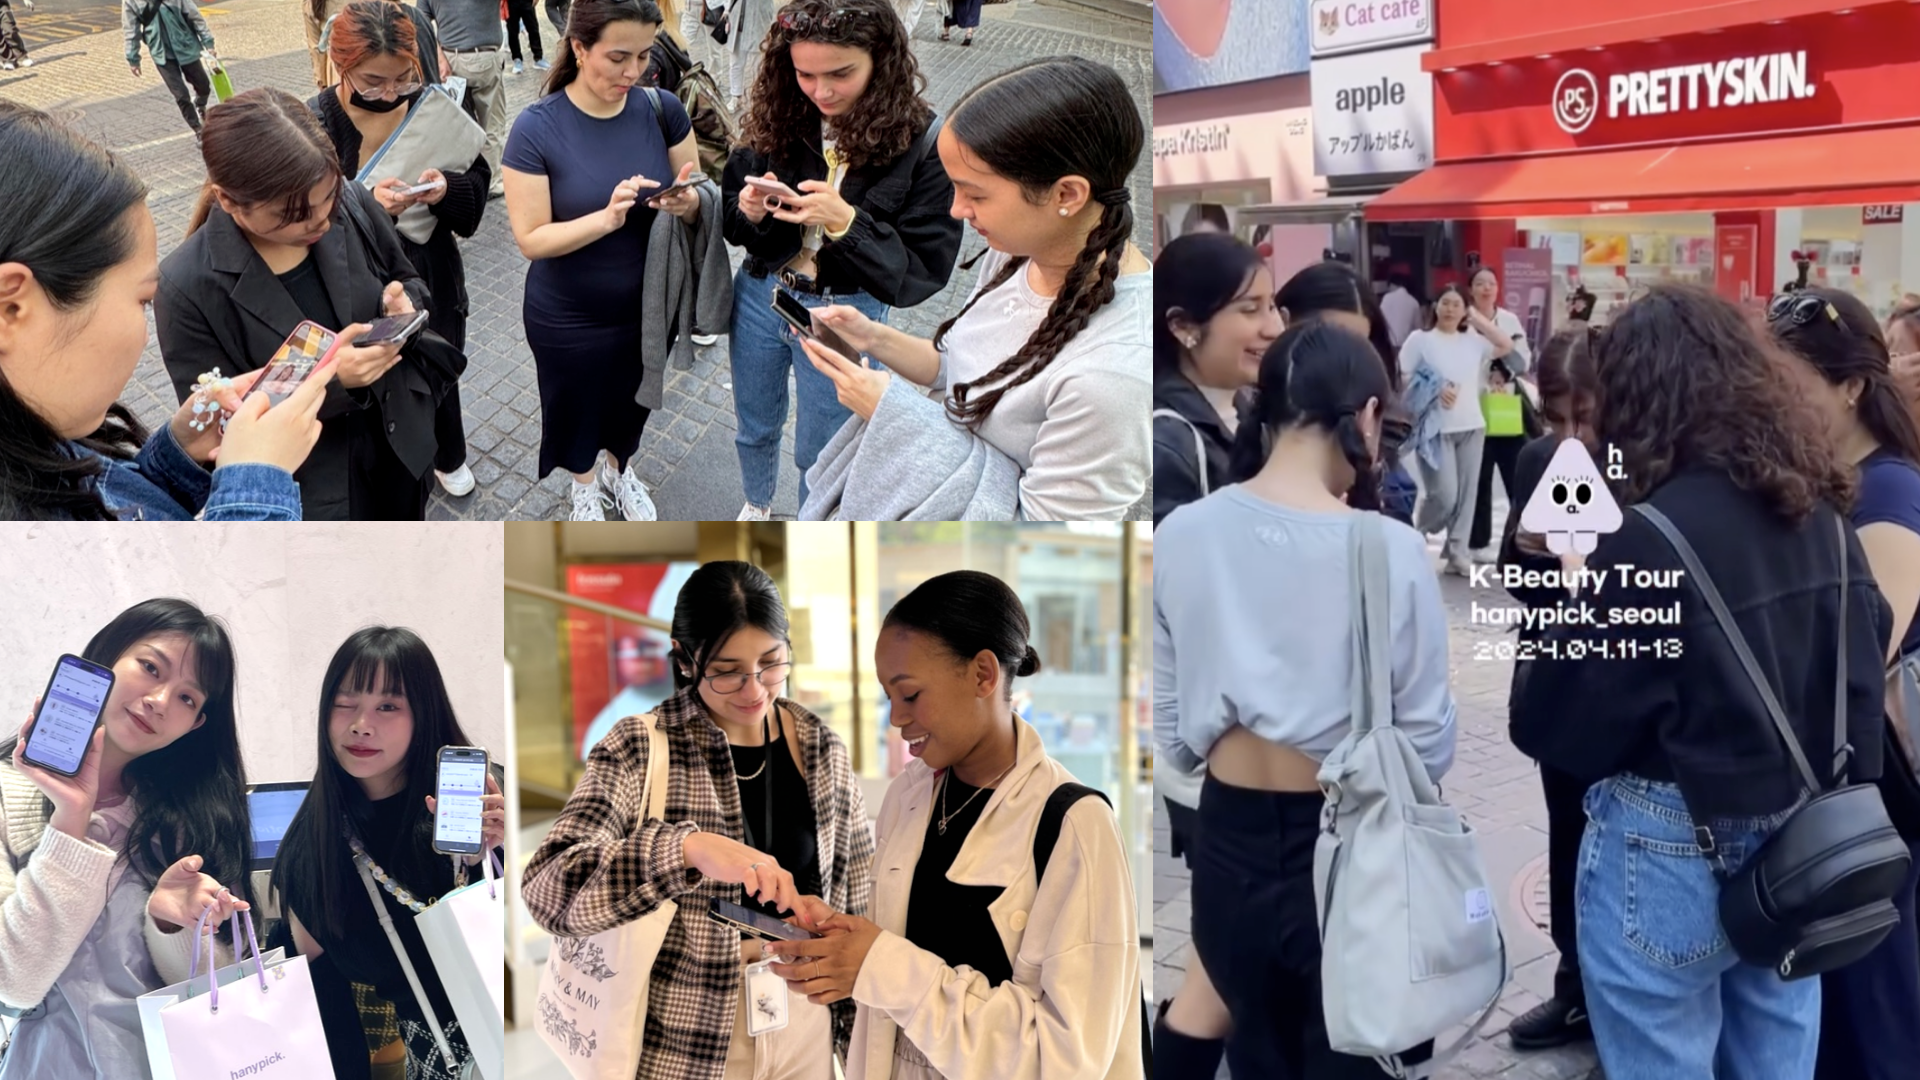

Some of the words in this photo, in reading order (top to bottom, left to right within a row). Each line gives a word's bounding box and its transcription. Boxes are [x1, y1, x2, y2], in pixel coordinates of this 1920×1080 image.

[1345, 2, 1375, 26] Cat
[1336, 77, 1405, 113] apple
[1608, 50, 1815, 118] PRETTYSKIN.
[1329, 129, 1415, 155] アップルかばん
[1865, 205, 1901, 219] SALE
[564, 981, 571, 996] &
[575, 987, 600, 1010] MAY
[230, 1051, 286, 1080] hanypick.
